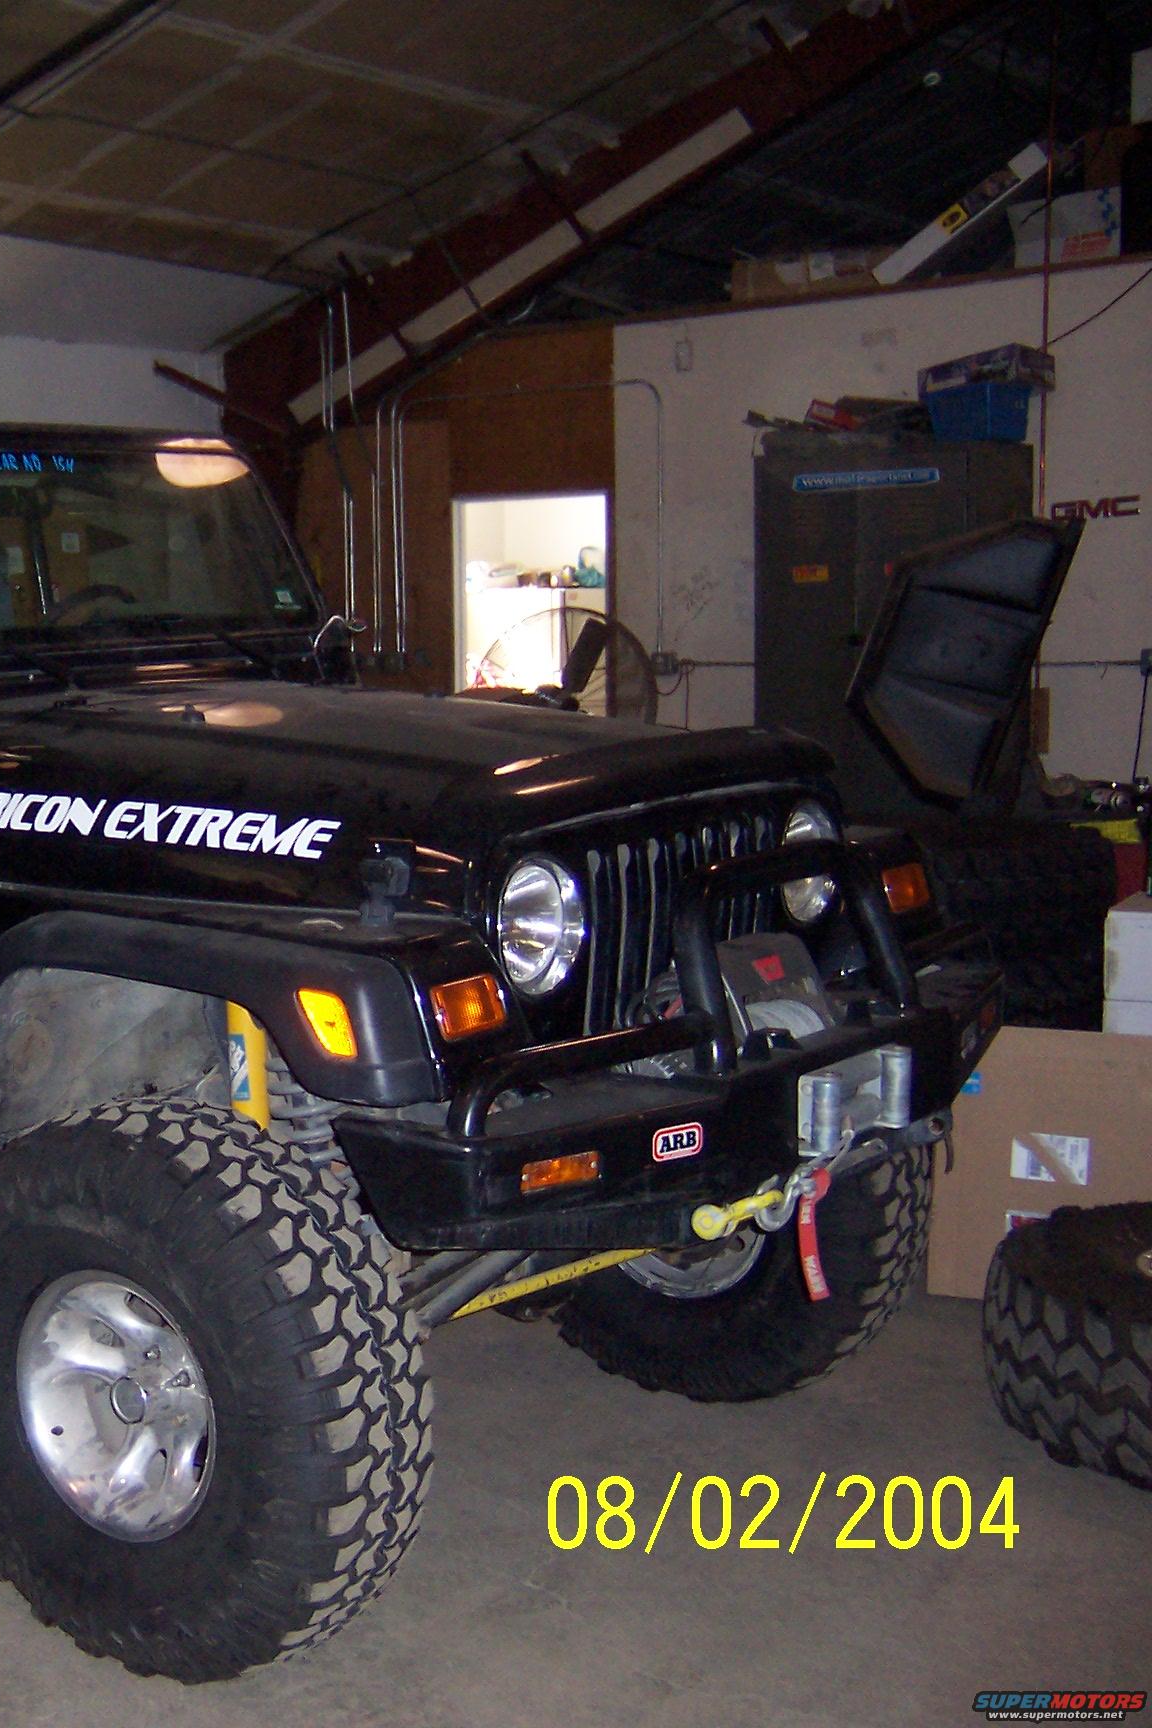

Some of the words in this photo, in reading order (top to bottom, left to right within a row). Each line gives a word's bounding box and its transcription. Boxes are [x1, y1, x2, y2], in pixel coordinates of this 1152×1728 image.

[1051, 495, 1140, 520] GMC
[102, 800, 342, 860] EXTREME
[659, 1130, 697, 1154] ARB
